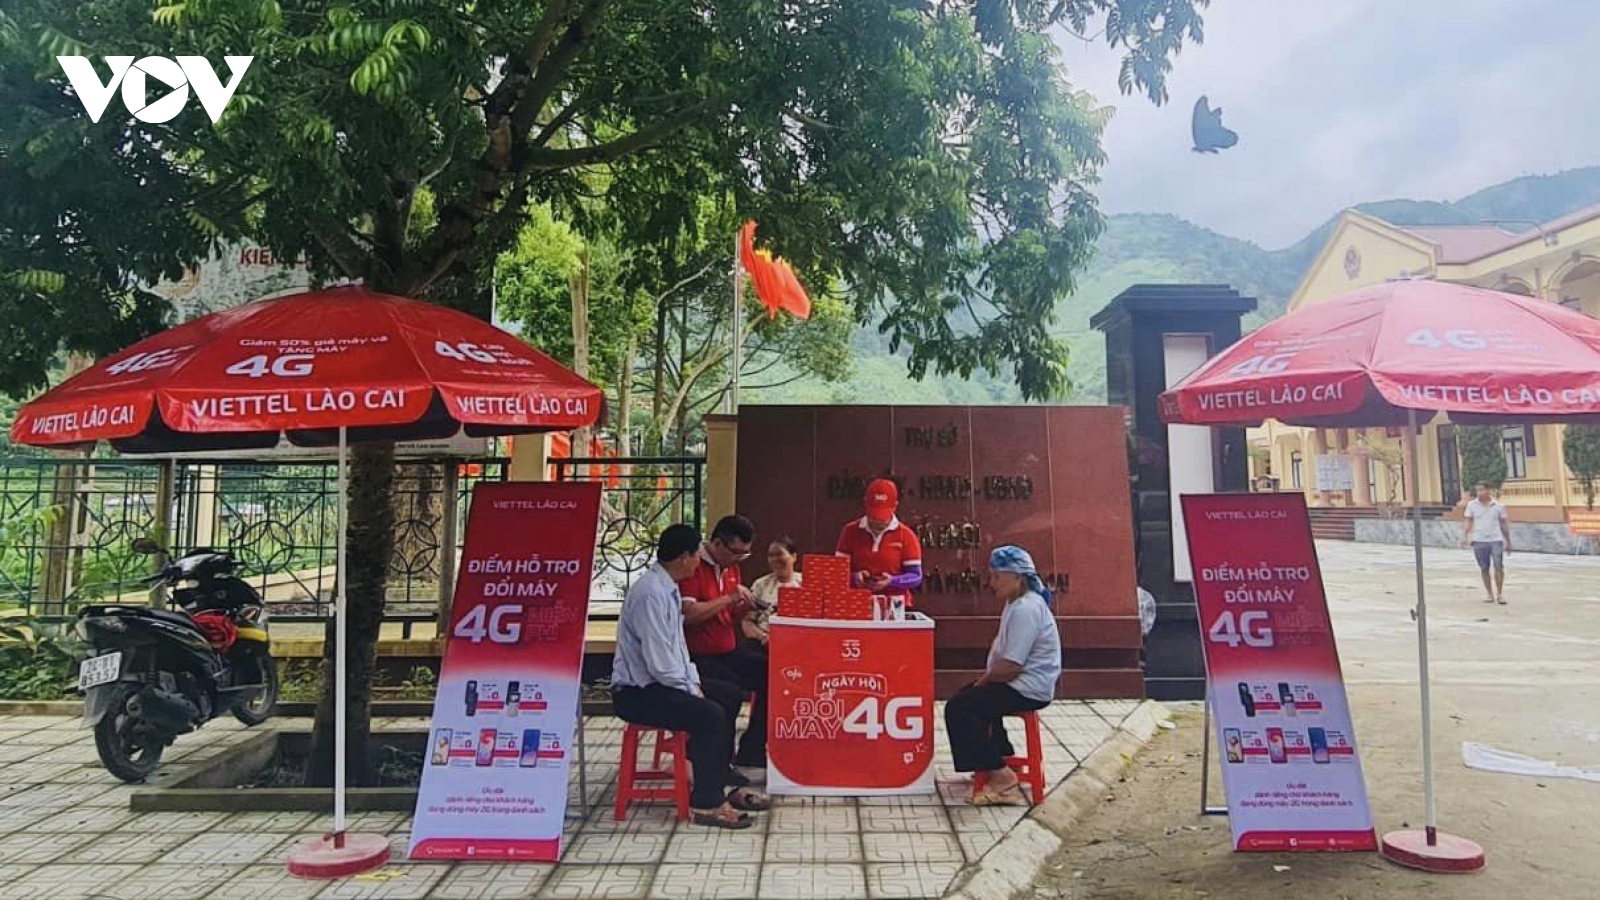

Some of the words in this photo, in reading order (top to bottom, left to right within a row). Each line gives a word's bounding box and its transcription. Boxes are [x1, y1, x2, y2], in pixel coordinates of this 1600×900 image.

[279, 338, 311, 346] 50%
[1405, 327, 1489, 350] 4G
[434, 340, 498, 363] 4G
[225, 353, 316, 378] 4G
[1230, 352, 1298, 376] 4G
[191, 393, 297, 418] VIETTEL
[305, 387, 355, 411] LÀO
[364, 389, 405, 408] CAI
[455, 396, 526, 415] VIETTEL
[529, 392, 561, 415] LÀO
[564, 398, 588, 415] CAI
[1198, 389, 1267, 411] VIETTEL
[1270, 383, 1306, 404] LÀO
[1311, 381, 1344, 402] CAI
[1397, 384, 1495, 404] VIETTEL
[1503, 382, 1554, 404] LÀO
[31, 412, 79, 435] VIETTEL
[82, 405, 107, 428] LÀO
[110, 404, 134, 426] CAI
[493, 501, 537, 509] VIETTEL
[537, 499, 558, 509] LÀO
[560, 500, 577, 509] CAI
[1205, 511, 1247, 520] VIETTEL
[1270, 510, 1287, 519] CAI
[468, 553, 511, 574] ĐIỂM
[514, 553, 541, 574] HỖ
[543, 559, 580, 576] TRỢ
[1201, 561, 1244, 581] ĐIỂM
[1247, 561, 1272, 581] HỖ
[1274, 566, 1310, 582] TRỢ
[484, 575, 514, 597] ĐỔI
[517, 579, 558, 597] MÁY
[1225, 583, 1254, 603] ĐỔI
[1256, 585, 1294, 603] MÁY
[453, 603, 523, 644] 4G
[1208, 609, 1274, 648] 4G
[821, 675, 855, 690] NGÀY
[858, 676, 881, 691] HỘI
[793, 688, 845, 720] ĐỔI
[843, 696, 924, 740] 4G
